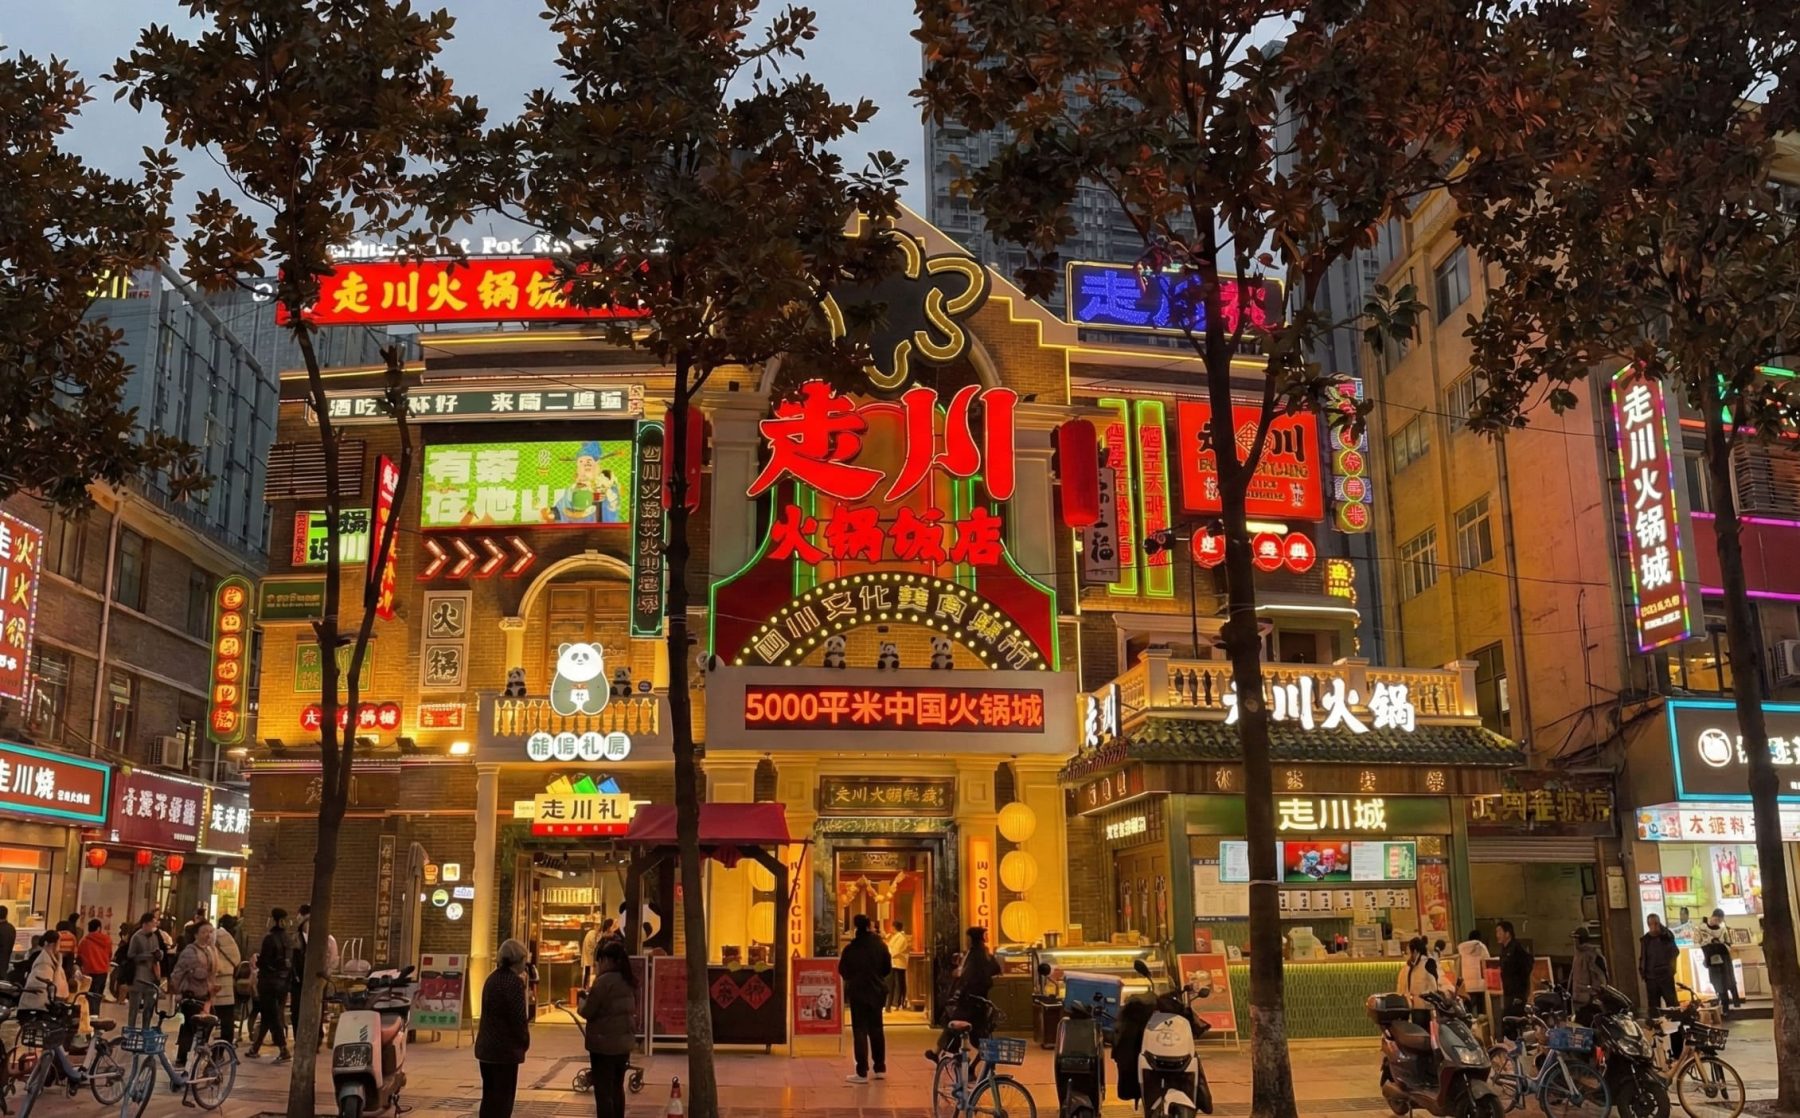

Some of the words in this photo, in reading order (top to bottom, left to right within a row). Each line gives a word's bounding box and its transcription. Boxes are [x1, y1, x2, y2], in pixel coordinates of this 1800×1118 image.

[482, 236, 523, 255] Pot
[332, 268, 608, 314] 走川火锅饭
[745, 379, 1019, 502] 走川
[1622, 384, 1674, 592] 走川火锅城
[769, 505, 1003, 565] 火锅饭店
[746, 689, 1044, 727] 5000平米中国火锅城
[541, 799, 622, 820] 走川礼
[1279, 799, 1387, 831] 走川城
